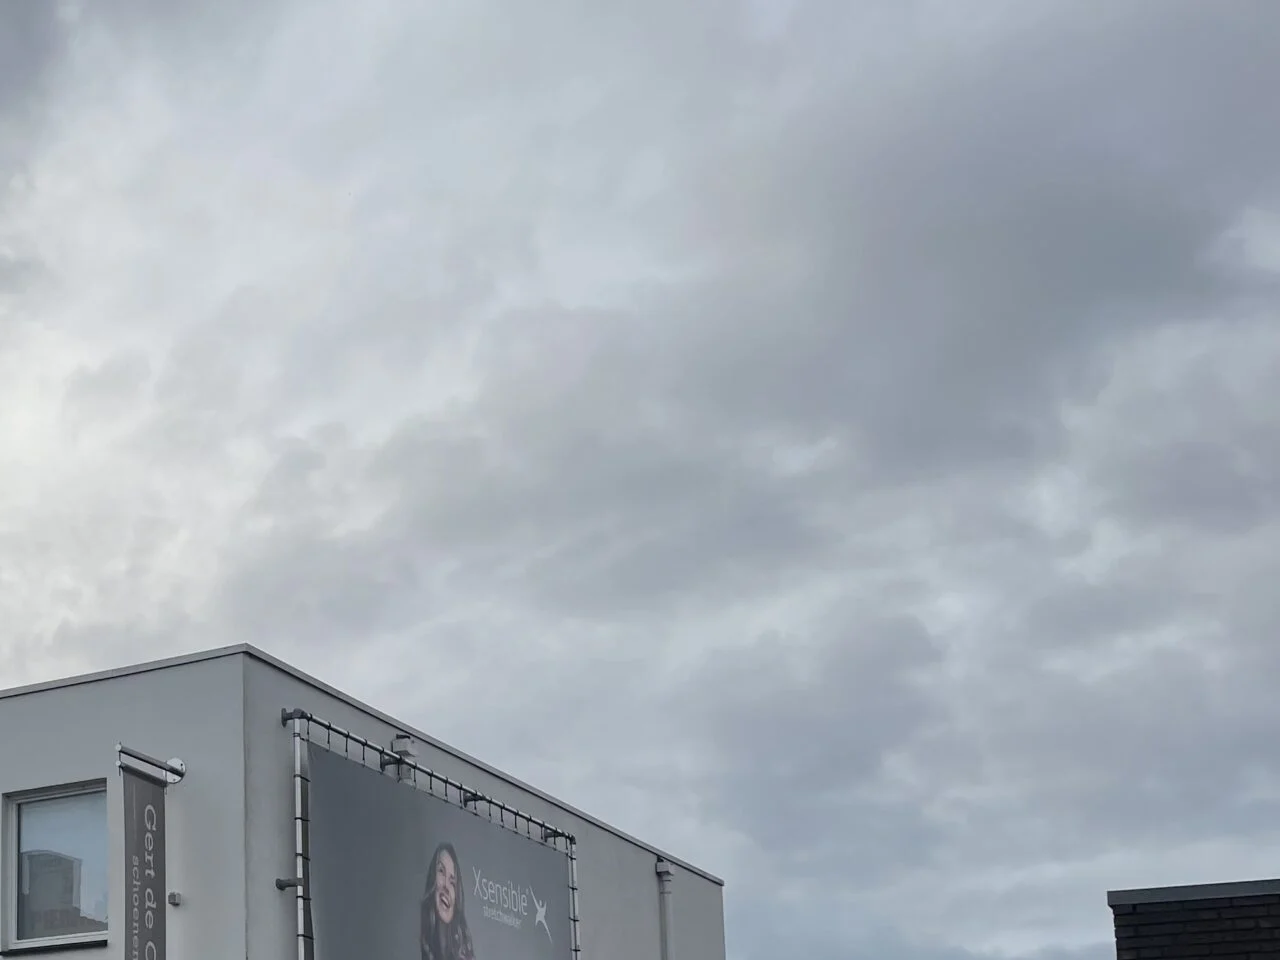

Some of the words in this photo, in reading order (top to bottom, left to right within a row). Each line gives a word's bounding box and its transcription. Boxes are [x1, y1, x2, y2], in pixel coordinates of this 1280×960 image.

[145, 804, 157, 879] Gert
[145, 888, 157, 930] de
[472, 865, 528, 916] Xsensible
